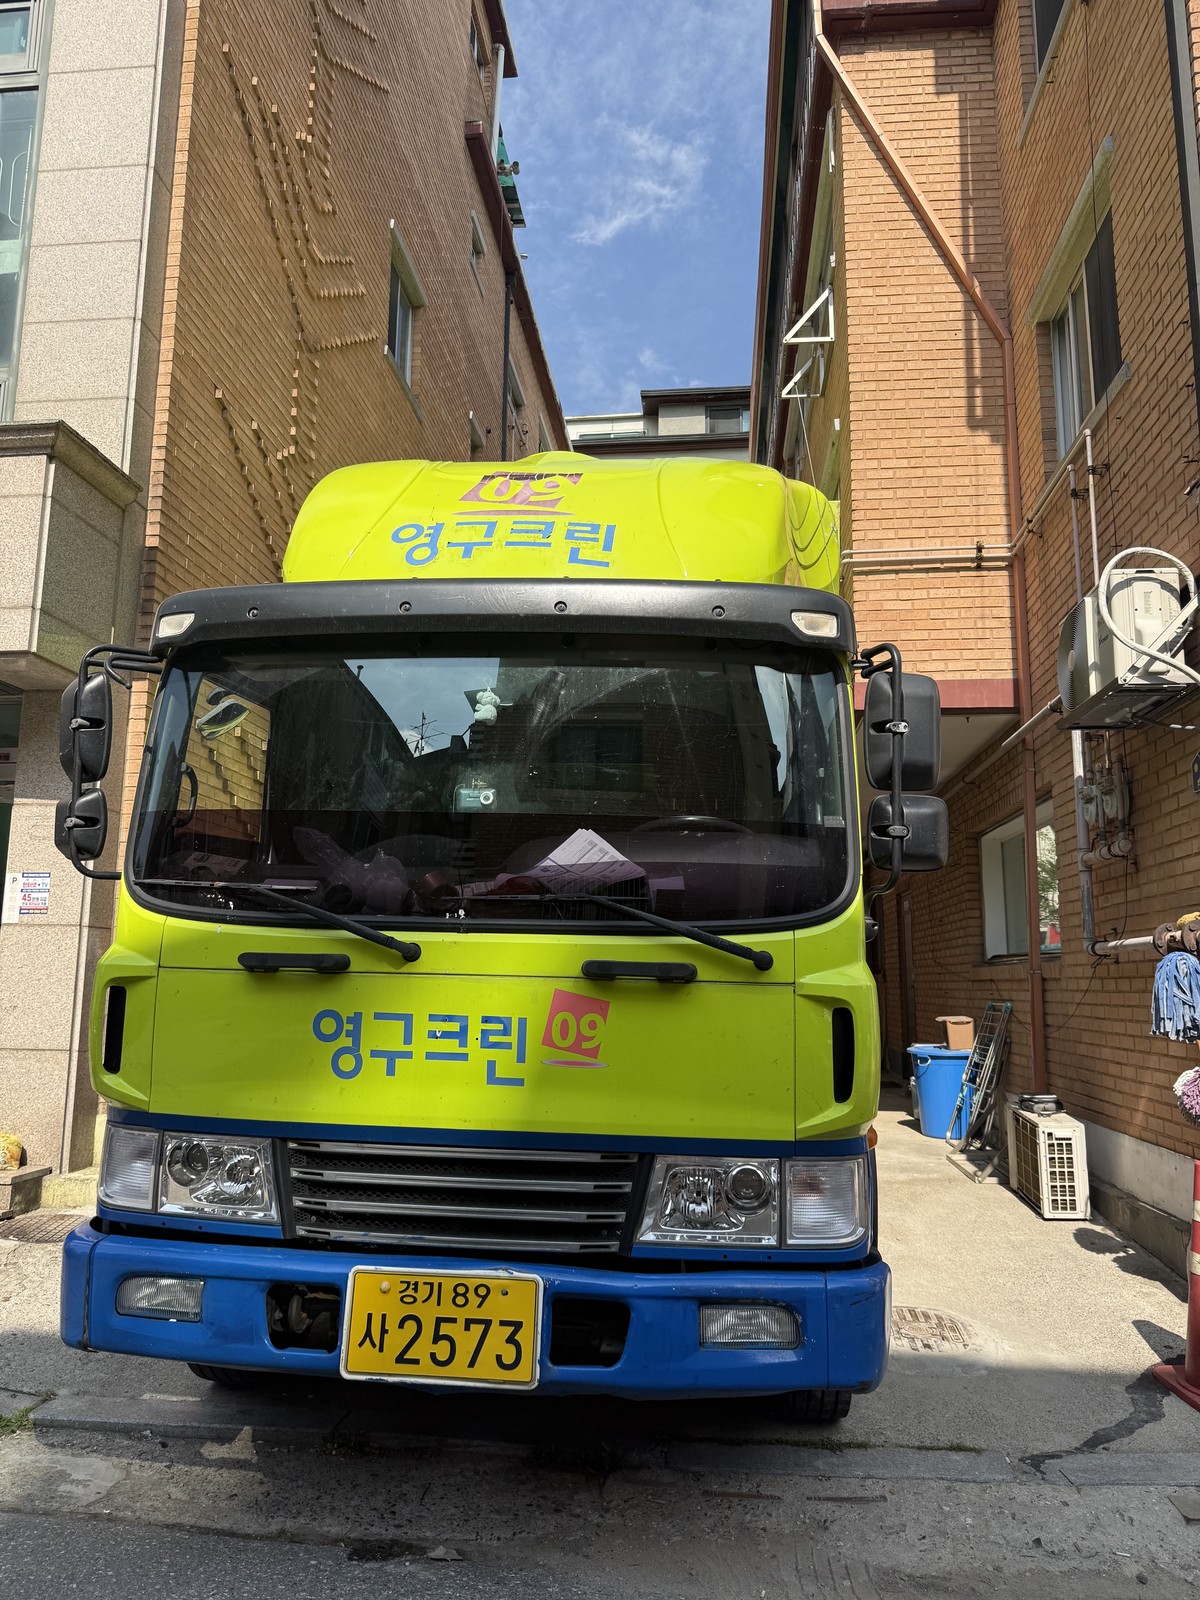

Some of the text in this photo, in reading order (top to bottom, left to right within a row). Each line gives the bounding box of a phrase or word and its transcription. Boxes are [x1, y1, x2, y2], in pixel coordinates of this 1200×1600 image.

[479, 475, 573, 502] 09
[391, 521, 615, 567] 영구크린
[21, 893, 31, 901] 45
[312, 1009, 607, 1087] 영구크린 09
